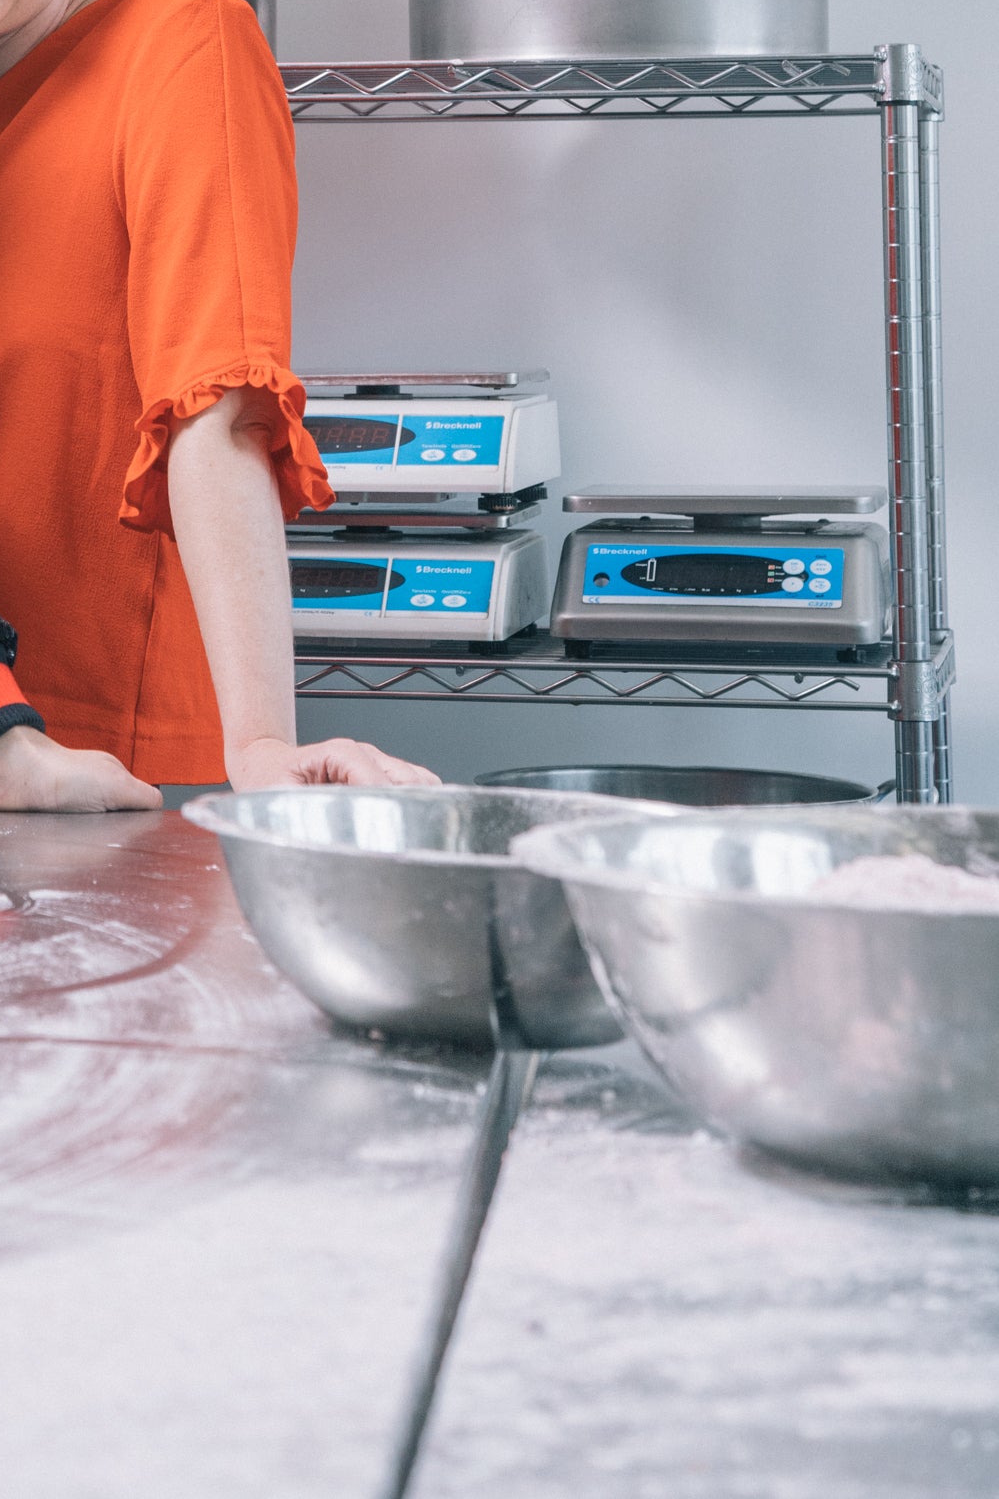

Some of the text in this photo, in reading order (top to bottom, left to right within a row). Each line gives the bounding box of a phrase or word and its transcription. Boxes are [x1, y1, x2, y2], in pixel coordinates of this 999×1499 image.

[432, 421, 482, 430] Brecknell
[599, 547, 648, 556] Brecknell
[422, 565, 472, 575] Brecknell
